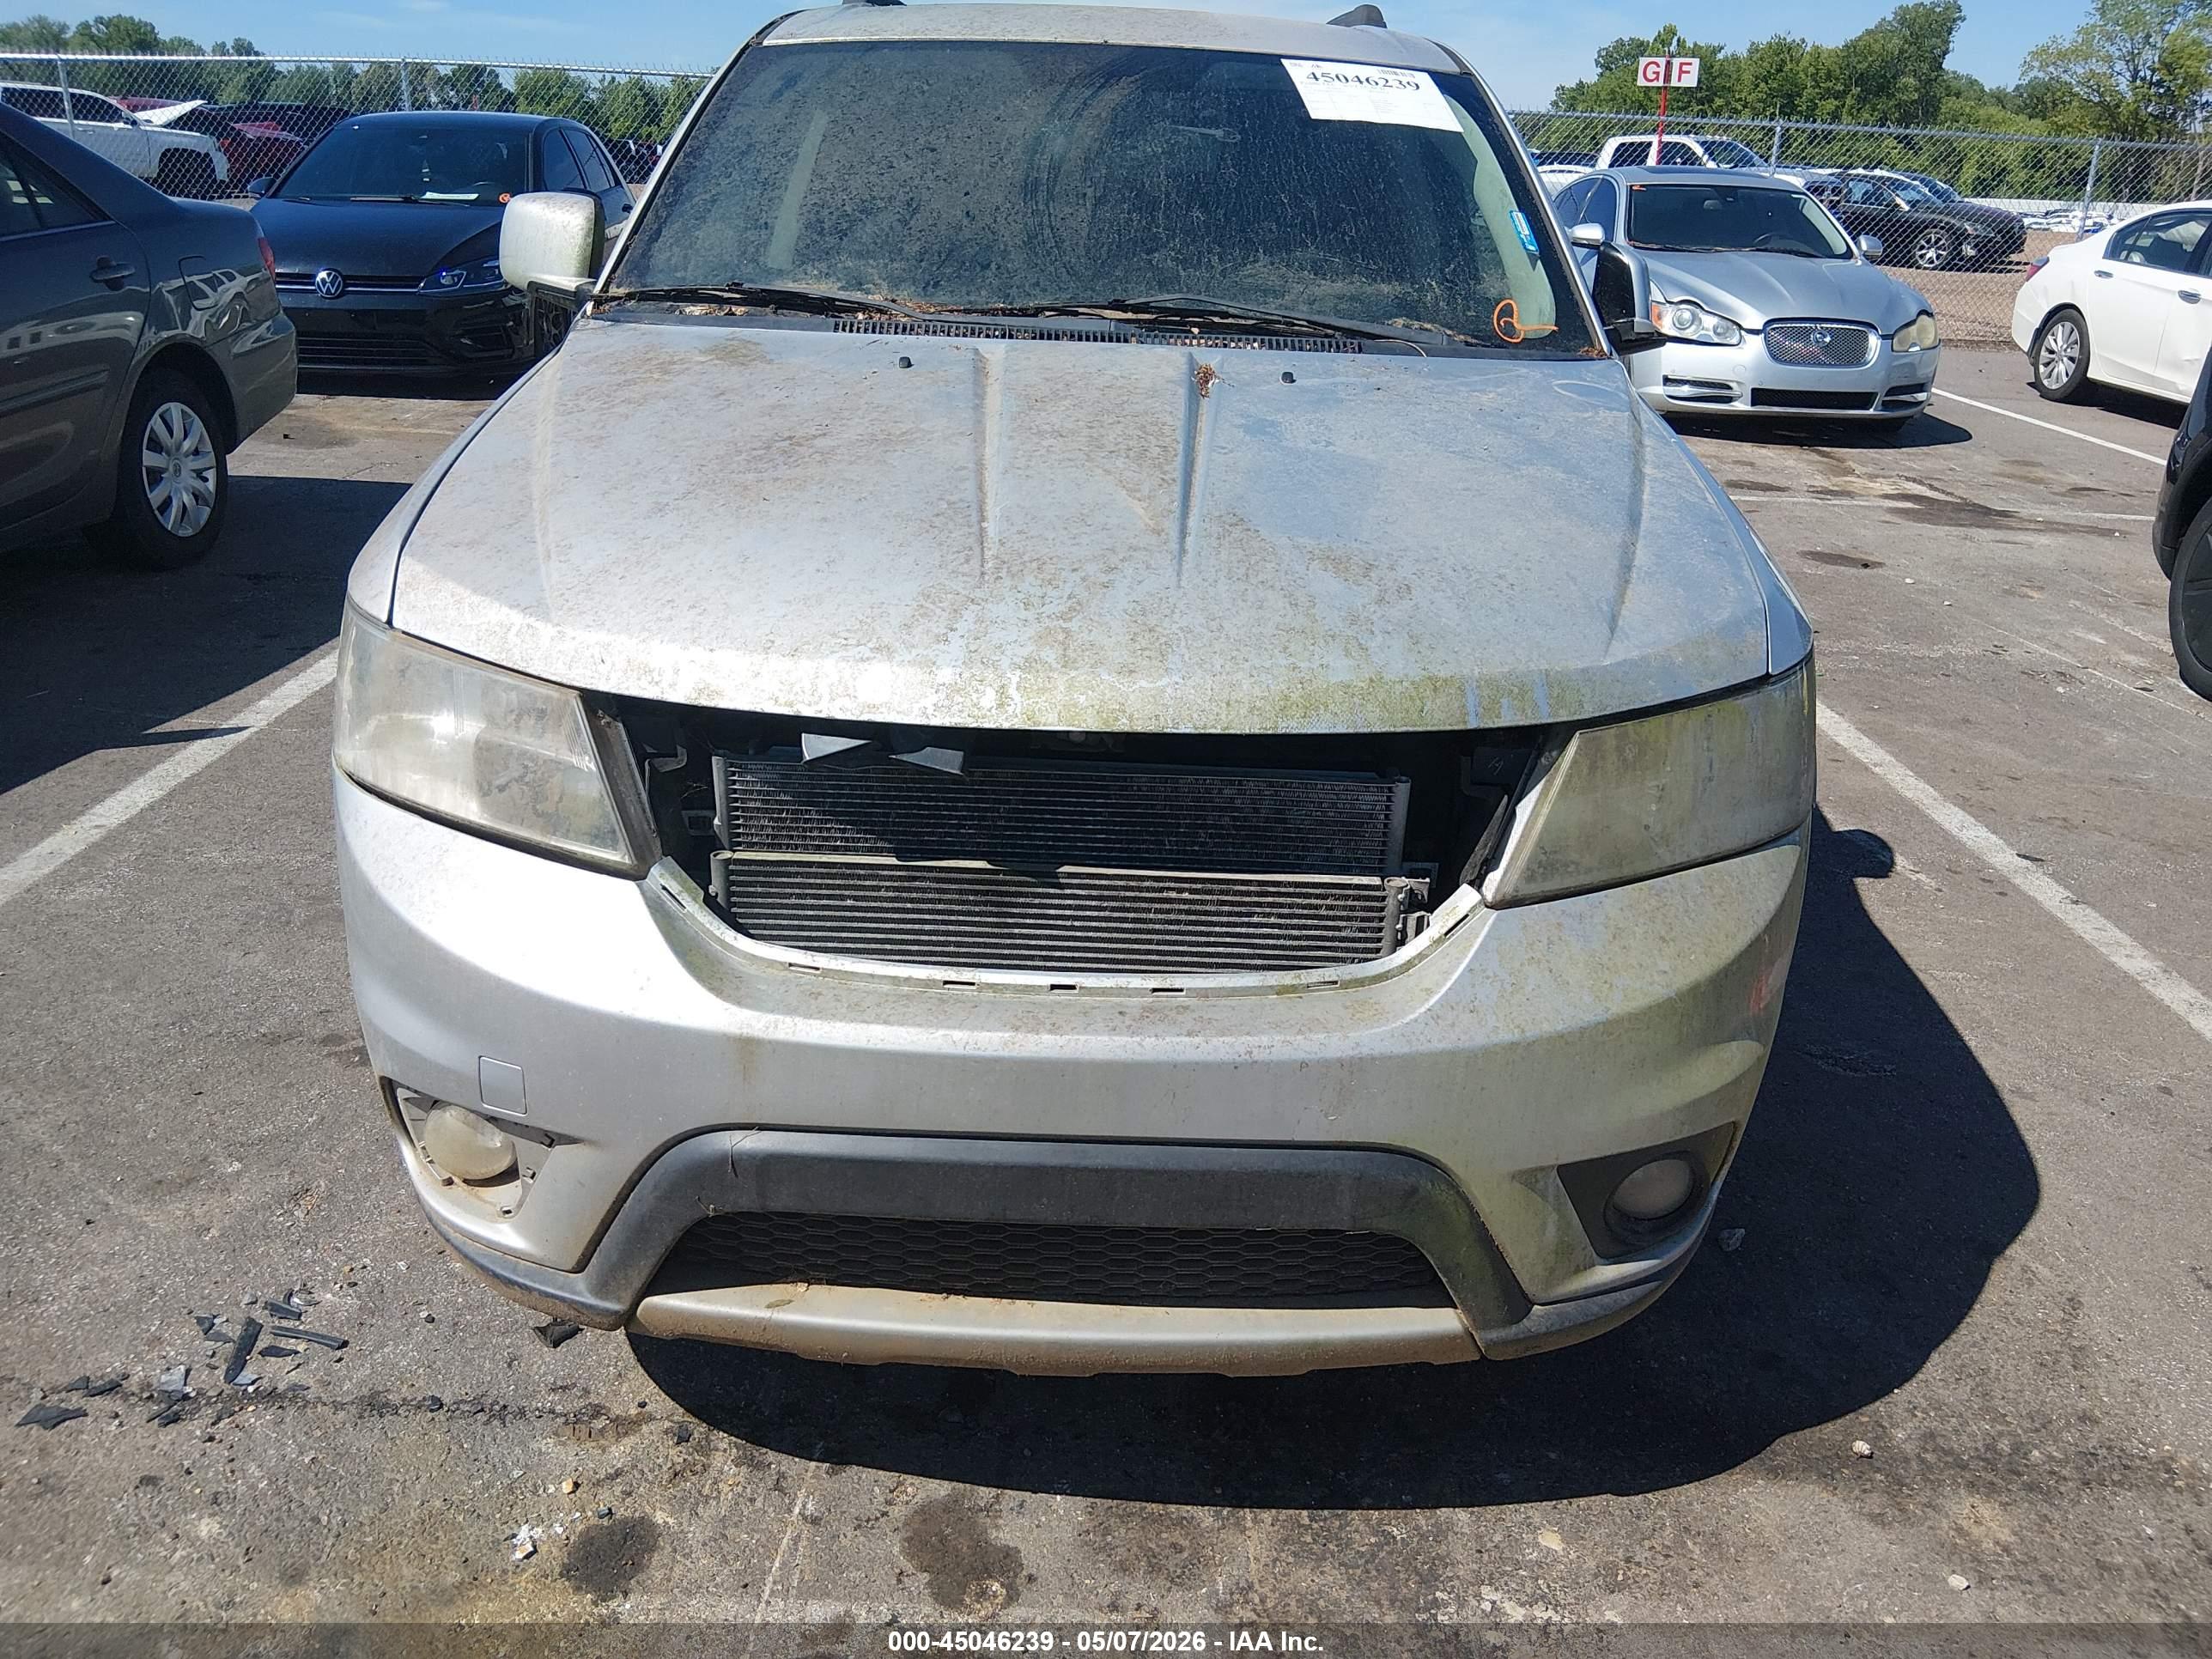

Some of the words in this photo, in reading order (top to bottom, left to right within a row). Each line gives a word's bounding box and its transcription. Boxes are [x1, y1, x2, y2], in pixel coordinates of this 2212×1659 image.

[1306, 71, 1420, 91] 45046239
[1642, 60, 1662, 83] G
[1677, 62, 1693, 83] F
